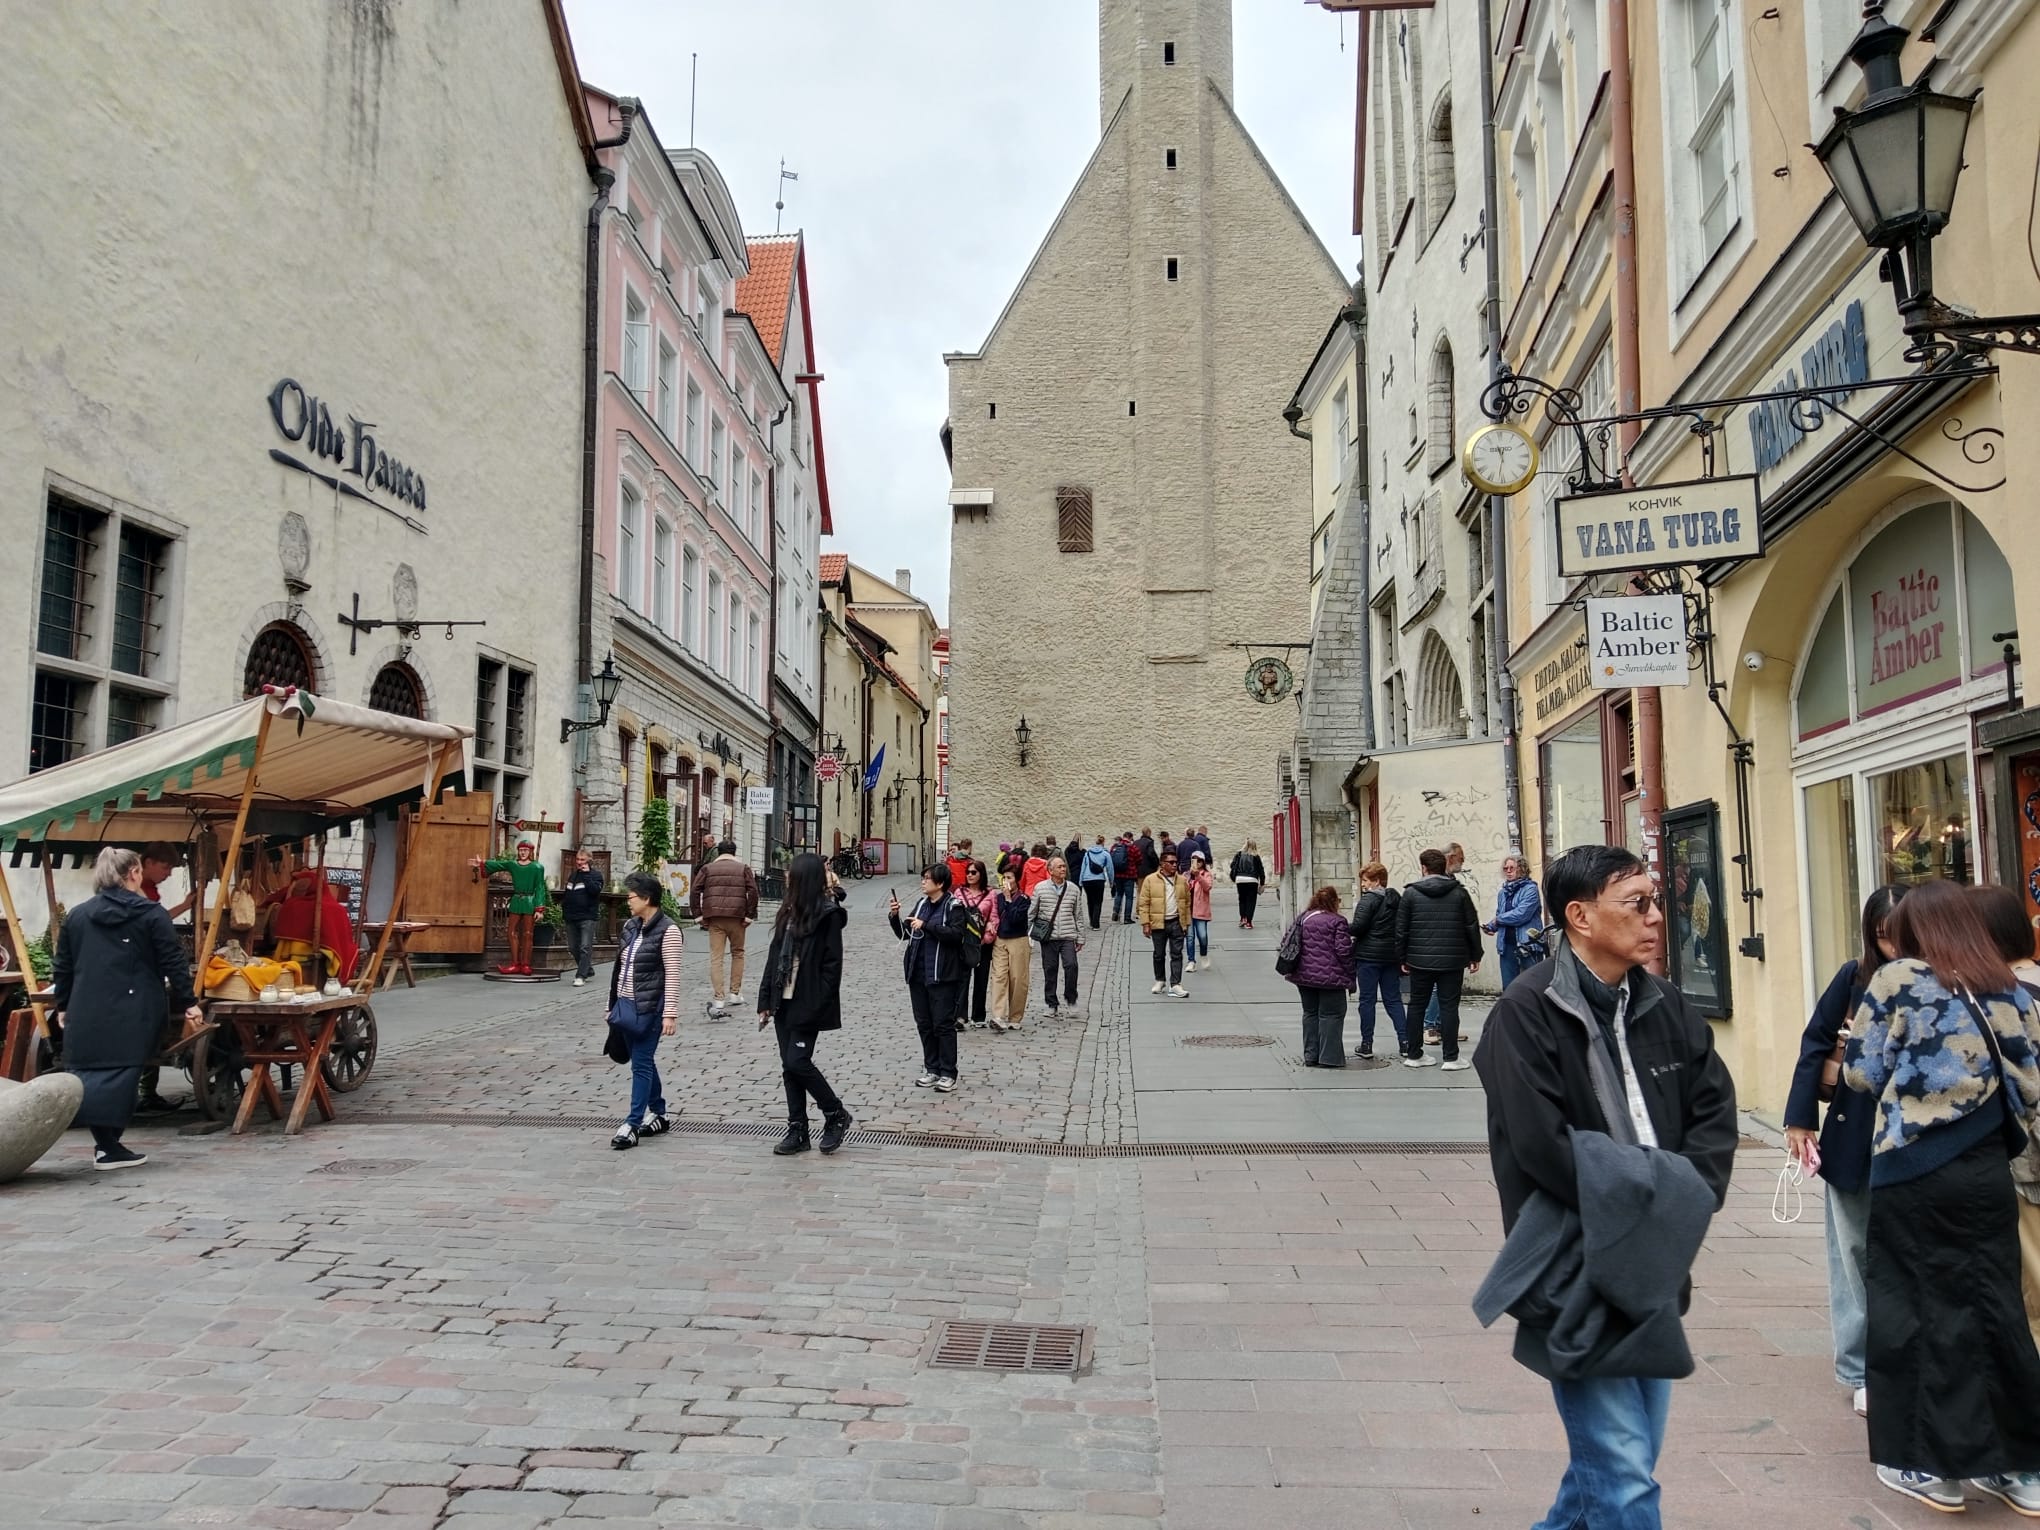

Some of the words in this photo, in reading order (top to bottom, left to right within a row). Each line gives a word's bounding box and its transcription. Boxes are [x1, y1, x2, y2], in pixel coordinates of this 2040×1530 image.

[1801, 298, 1868, 430] TURG
[267, 378, 345, 464] Olde
[1629, 496, 1682, 512] KOHVIK
[1576, 518, 1656, 558] VANA
[1663, 508, 1741, 548] TURG
[1601, 612, 1673, 632] Baltic
[1871, 568, 1940, 639] Baltic
[1596, 637, 1680, 657] Amber
[1869, 621, 1945, 686] Amber
